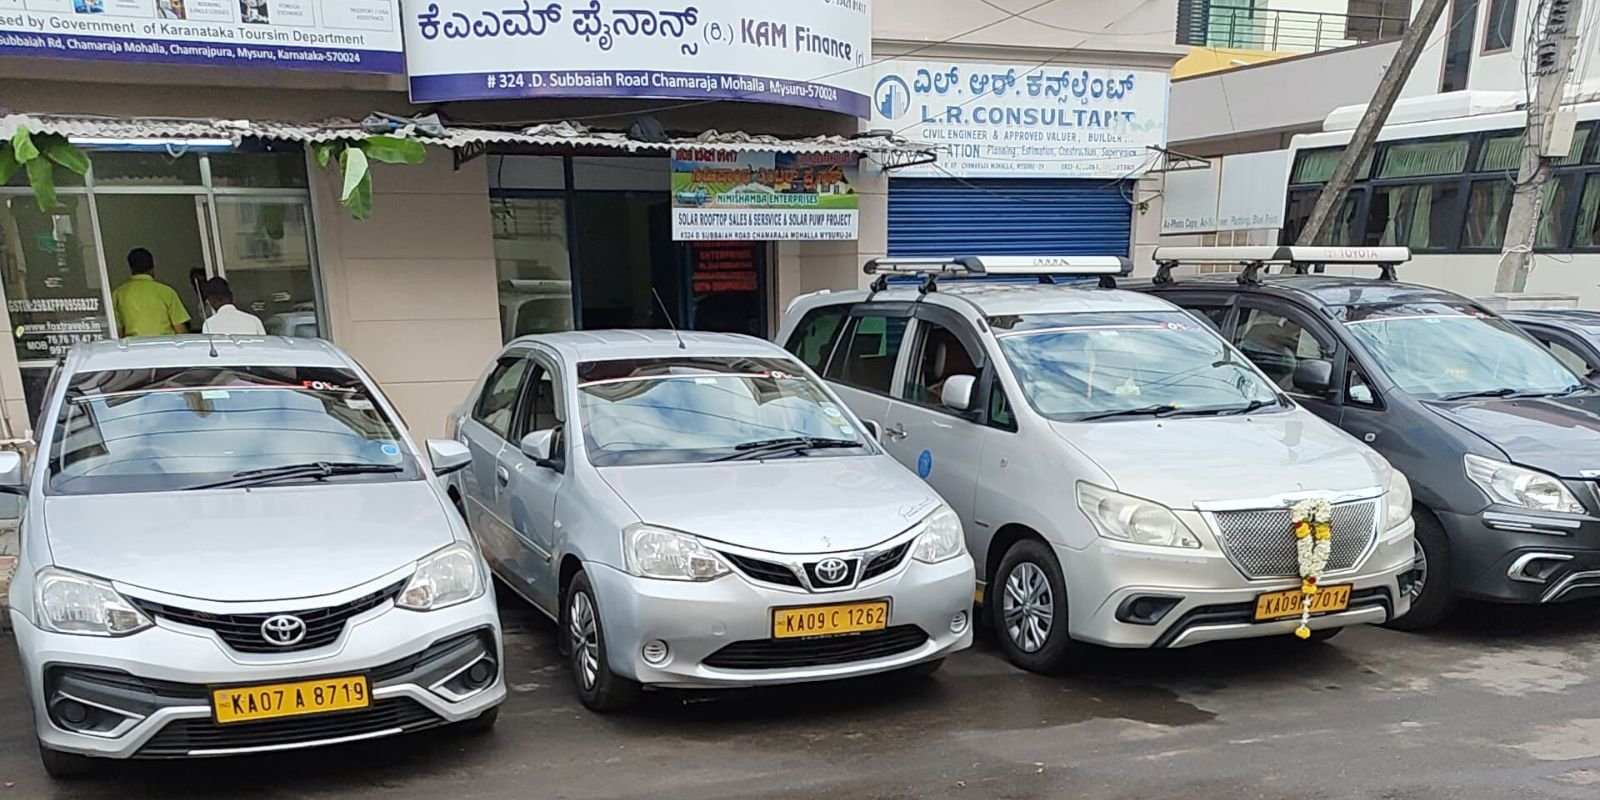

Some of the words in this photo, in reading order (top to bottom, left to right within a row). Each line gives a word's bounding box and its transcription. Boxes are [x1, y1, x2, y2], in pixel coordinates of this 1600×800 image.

[27, 15, 45, 30] by
[49, 16, 136, 34] Government
[143, 22, 156, 35] of
[160, 23, 234, 38] Karanataka
[238, 27, 289, 42] Toursim
[293, 30, 366, 46] Department
[741, 18, 787, 49] KAM
[795, 26, 852, 61] Finance
[48, 38, 66, 50] Rd,
[67, 39, 122, 54] Chamaraja
[124, 42, 168, 56] Mohalla,
[170, 45, 236, 59] Chamrajpura,
[237, 47, 277, 61] Mysuru,
[278, 49, 361, 63] Karnataka-570024
[499, 73, 525, 88] 324
[549, 72, 612, 88] Subbaiah
[616, 72, 649, 88] Road
[652, 73, 718, 92] Chamaraja
[720, 76, 765, 93] Mohalla
[769, 81, 838, 102] Mysuru-570024
[922, 129, 946, 139] CIVIL
[948, 129, 988, 140] ENGINEER
[992, 130, 999, 140] &
[1004, 131, 1043, 142] APPROVED
[717, 194, 767, 204] NIMISHAMBA
[769, 195, 818, 204] ENTERPRISES
[678, 212, 698, 226] SOLAR
[699, 212, 727, 226] ROOFTOP
[728, 212, 747, 226] SALES
[747, 213, 752, 226] &
[753, 213, 781, 226] SERSVICE
[783, 213, 788, 226] &
[789, 213, 808, 226] SOLAR
[809, 213, 825, 226] PUMP
[826, 213, 852, 227] PROJECT
[701, 232, 733, 240] SUBBAIAH
[735, 232, 751, 240] ROAD
[752, 232, 789, 240] CHAMARAJA
[790, 232, 818, 240] MOHALLA
[1340, 249, 1378, 259] TOYOTA
[26, 341, 48, 351] MOB
[302, 380, 332, 391] FOX
[786, 612, 825, 633] KA09
[831, 611, 840, 628] C
[847, 606, 885, 627] 1262
[231, 690, 284, 715] KA07
[295, 688, 305, 709] A
[313, 682, 364, 706] 8719
